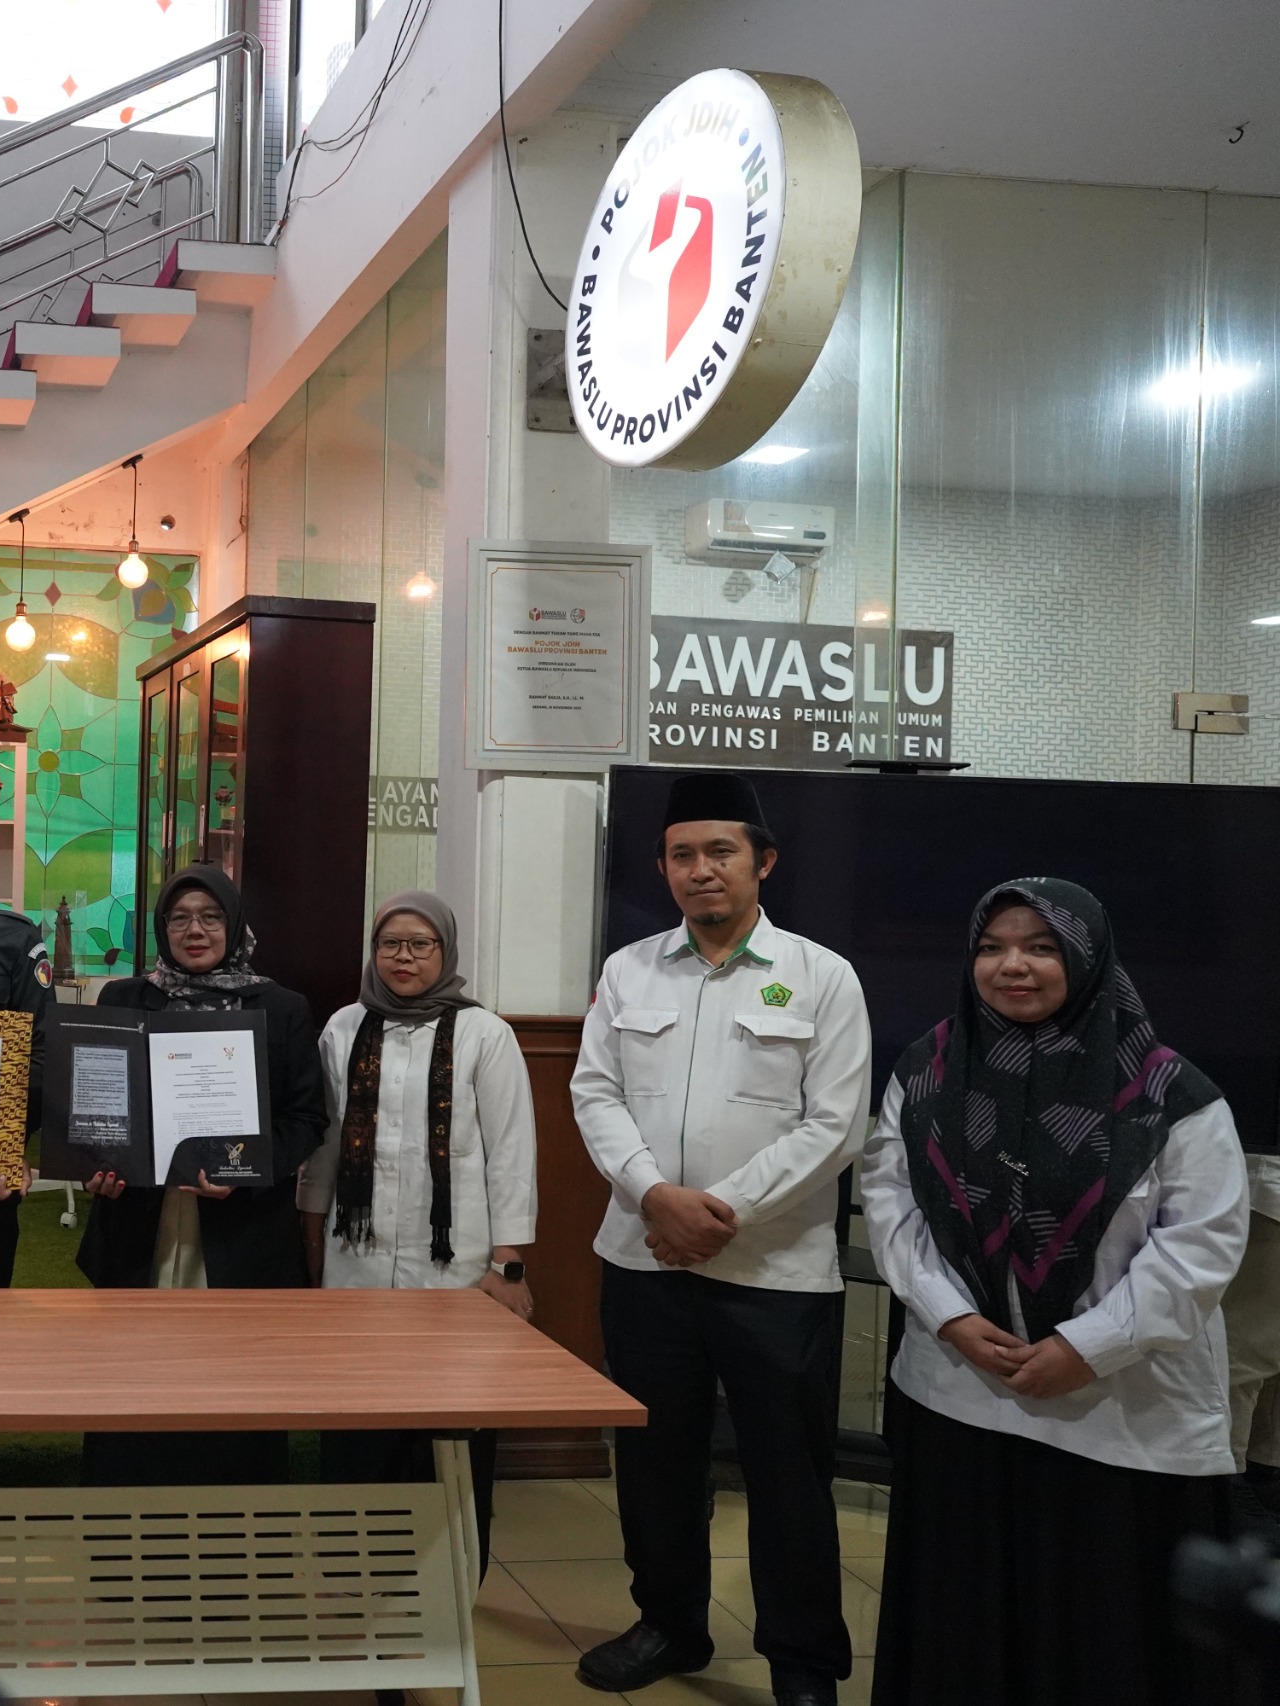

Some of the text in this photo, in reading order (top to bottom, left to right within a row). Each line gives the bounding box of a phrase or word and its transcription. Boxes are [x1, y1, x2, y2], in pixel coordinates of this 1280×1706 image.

[601, 101, 740, 235] POJOK JDIH
[577, 142, 768, 445] BAWASLU PROVINSI BANTEN
[507, 646, 543, 654] BAWASLU
[691, 703, 781, 721] PENGAWAS
[794, 708, 879, 724] PEMILIHAN
[897, 712, 943, 727] UMUM
[812, 731, 943, 758] BANTEN
